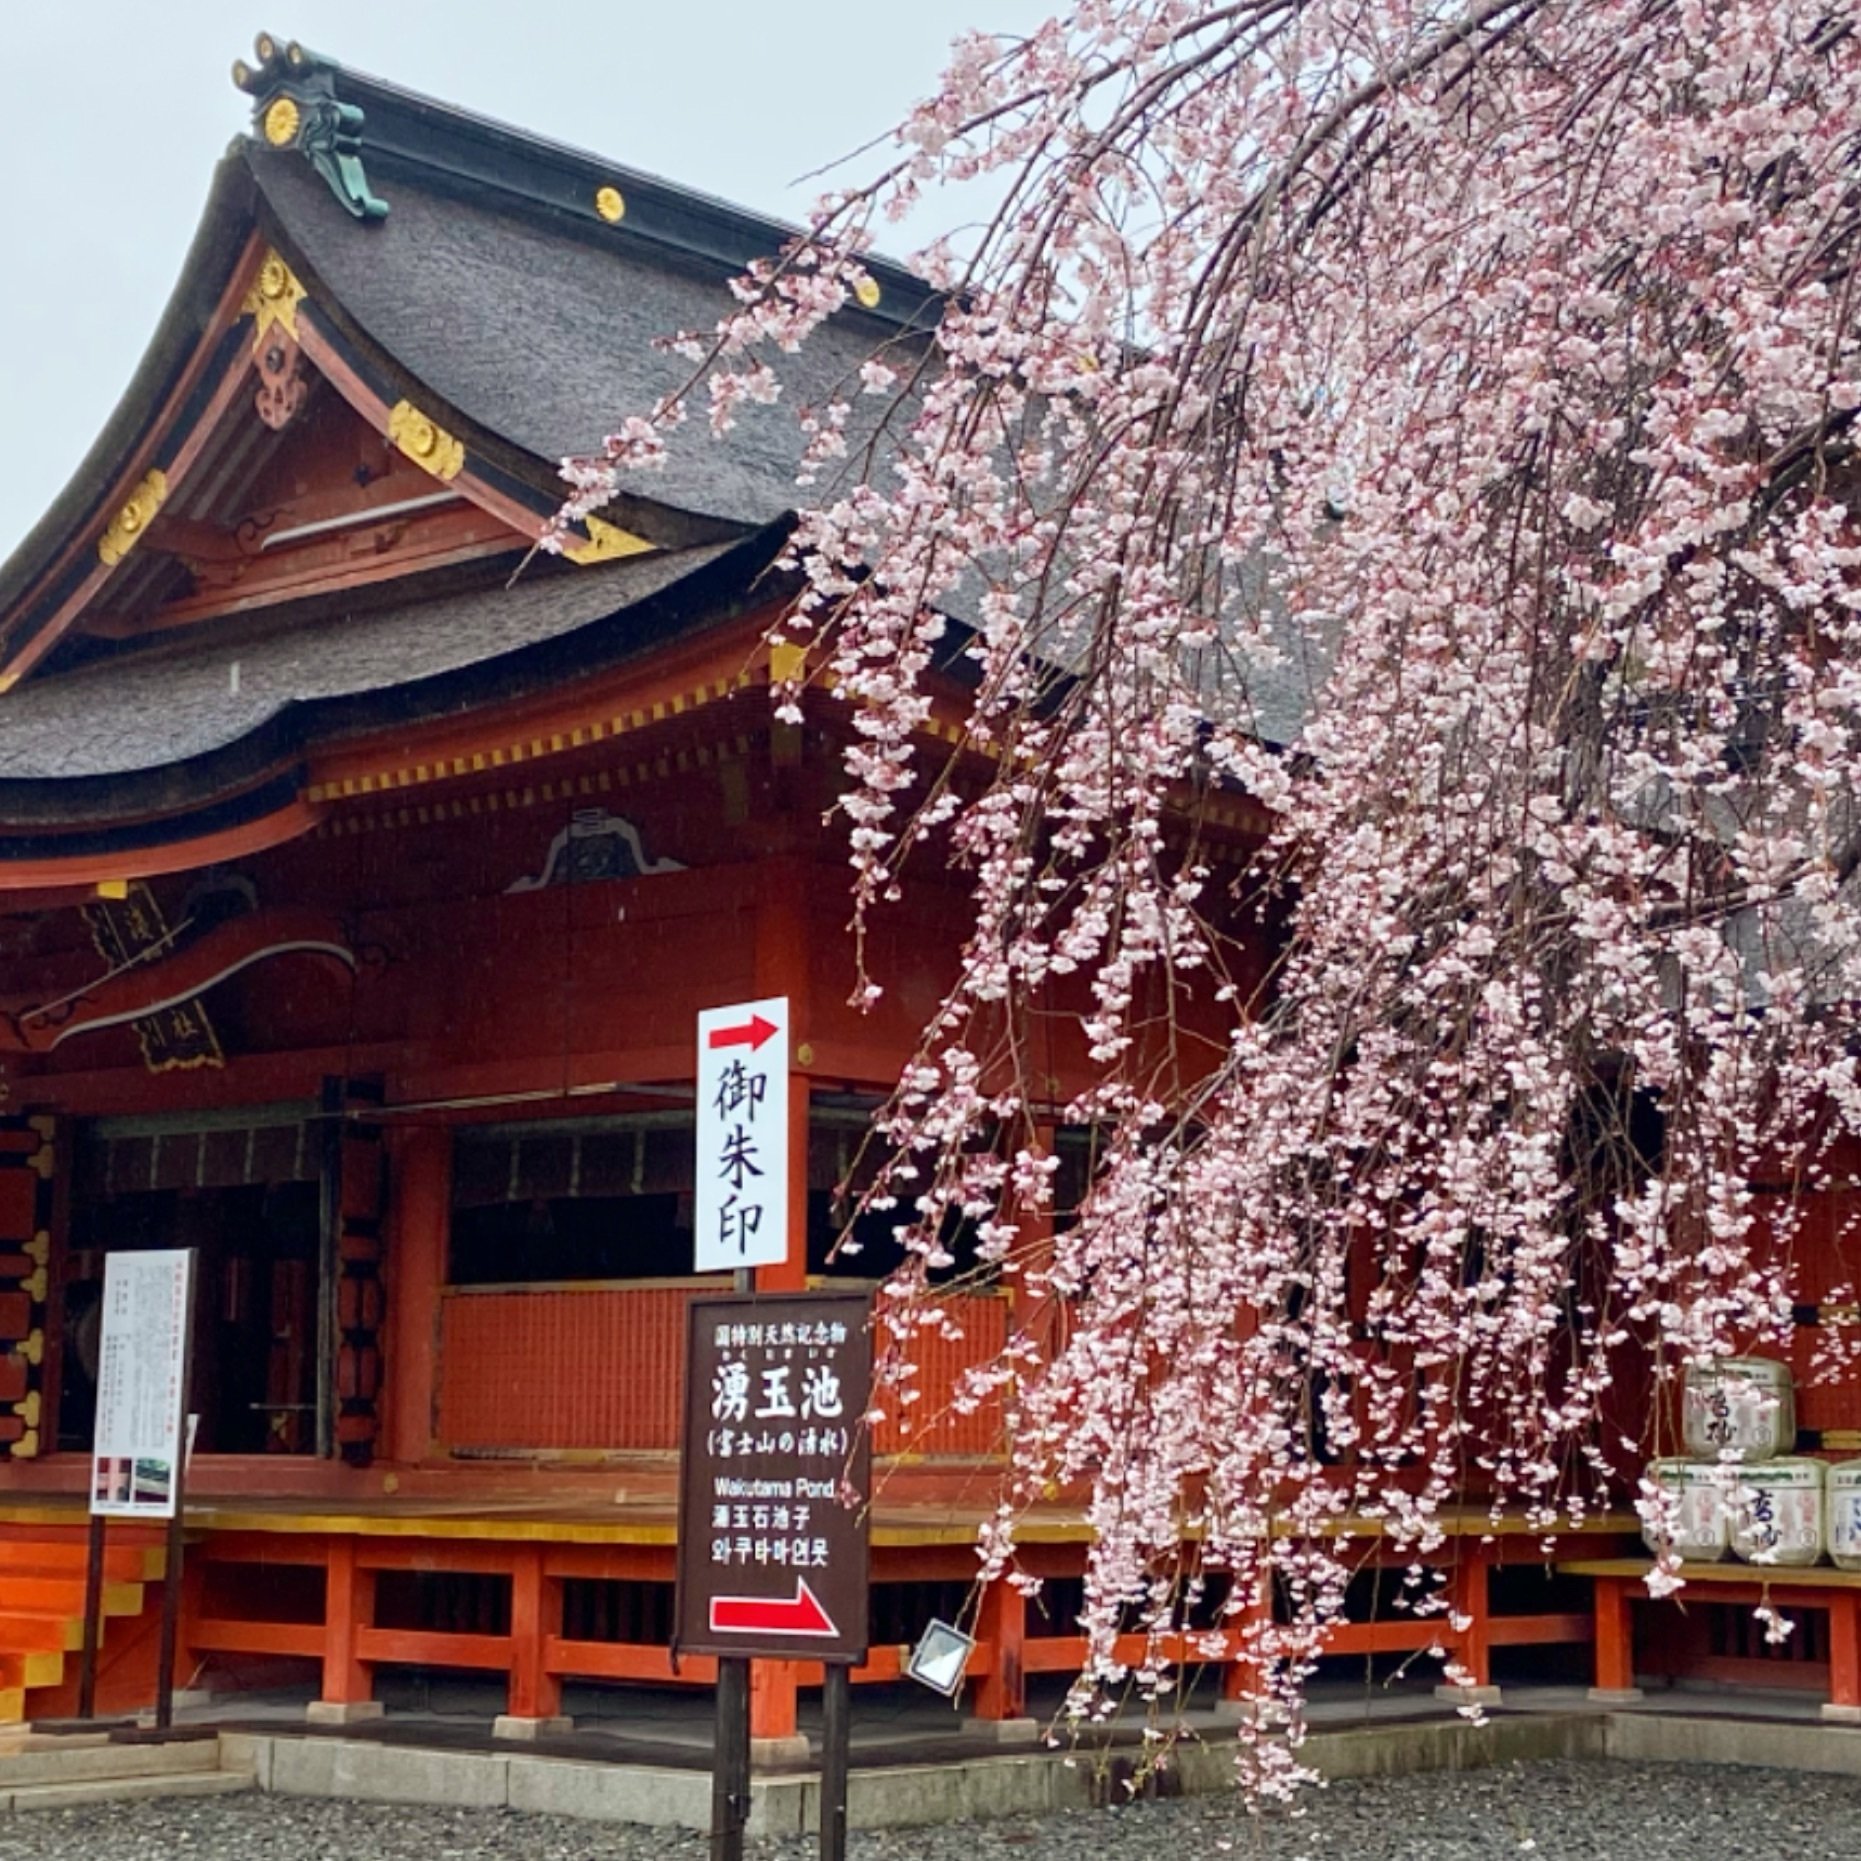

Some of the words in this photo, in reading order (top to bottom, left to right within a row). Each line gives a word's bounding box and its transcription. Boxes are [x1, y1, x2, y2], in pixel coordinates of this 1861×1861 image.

[713, 1059, 767, 1255] 御朱印
[711, 1362, 844, 1422] 湧玉池
[714, 1477, 792, 1498] Wakutama
[795, 1477, 835, 1498] Pond
